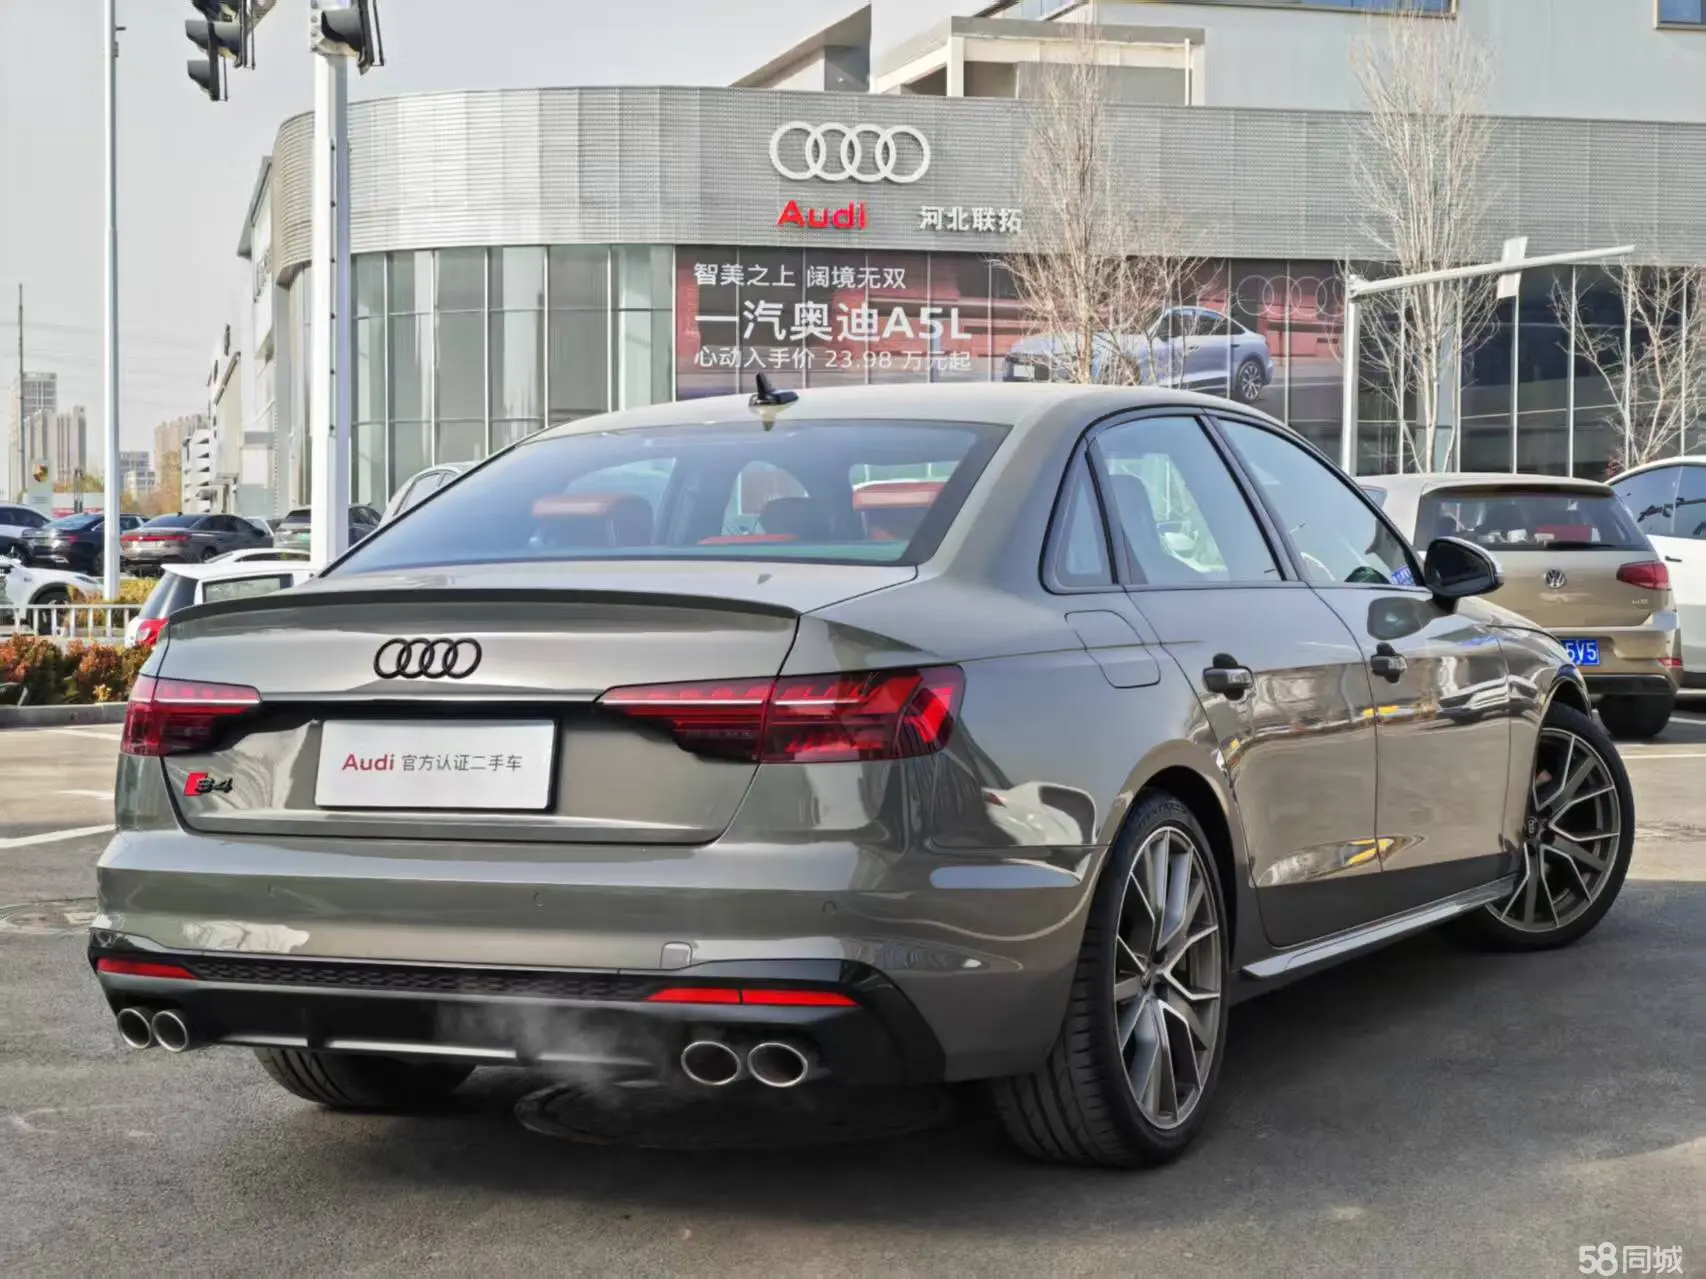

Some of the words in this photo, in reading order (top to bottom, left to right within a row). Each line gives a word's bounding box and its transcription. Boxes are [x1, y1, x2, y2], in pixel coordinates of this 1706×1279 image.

[777, 200, 867, 230] Audi
[919, 205, 1022, 232] 河北联拓
[693, 263, 796, 287] 智美之上
[807, 265, 906, 289] 阔境无双
[694, 300, 973, 342] 一汽奥迪A5L
[693, 346, 816, 369] 心动入手价
[342, 754, 395, 771] Audi
[401, 754, 523, 771] 官方认证二手车
